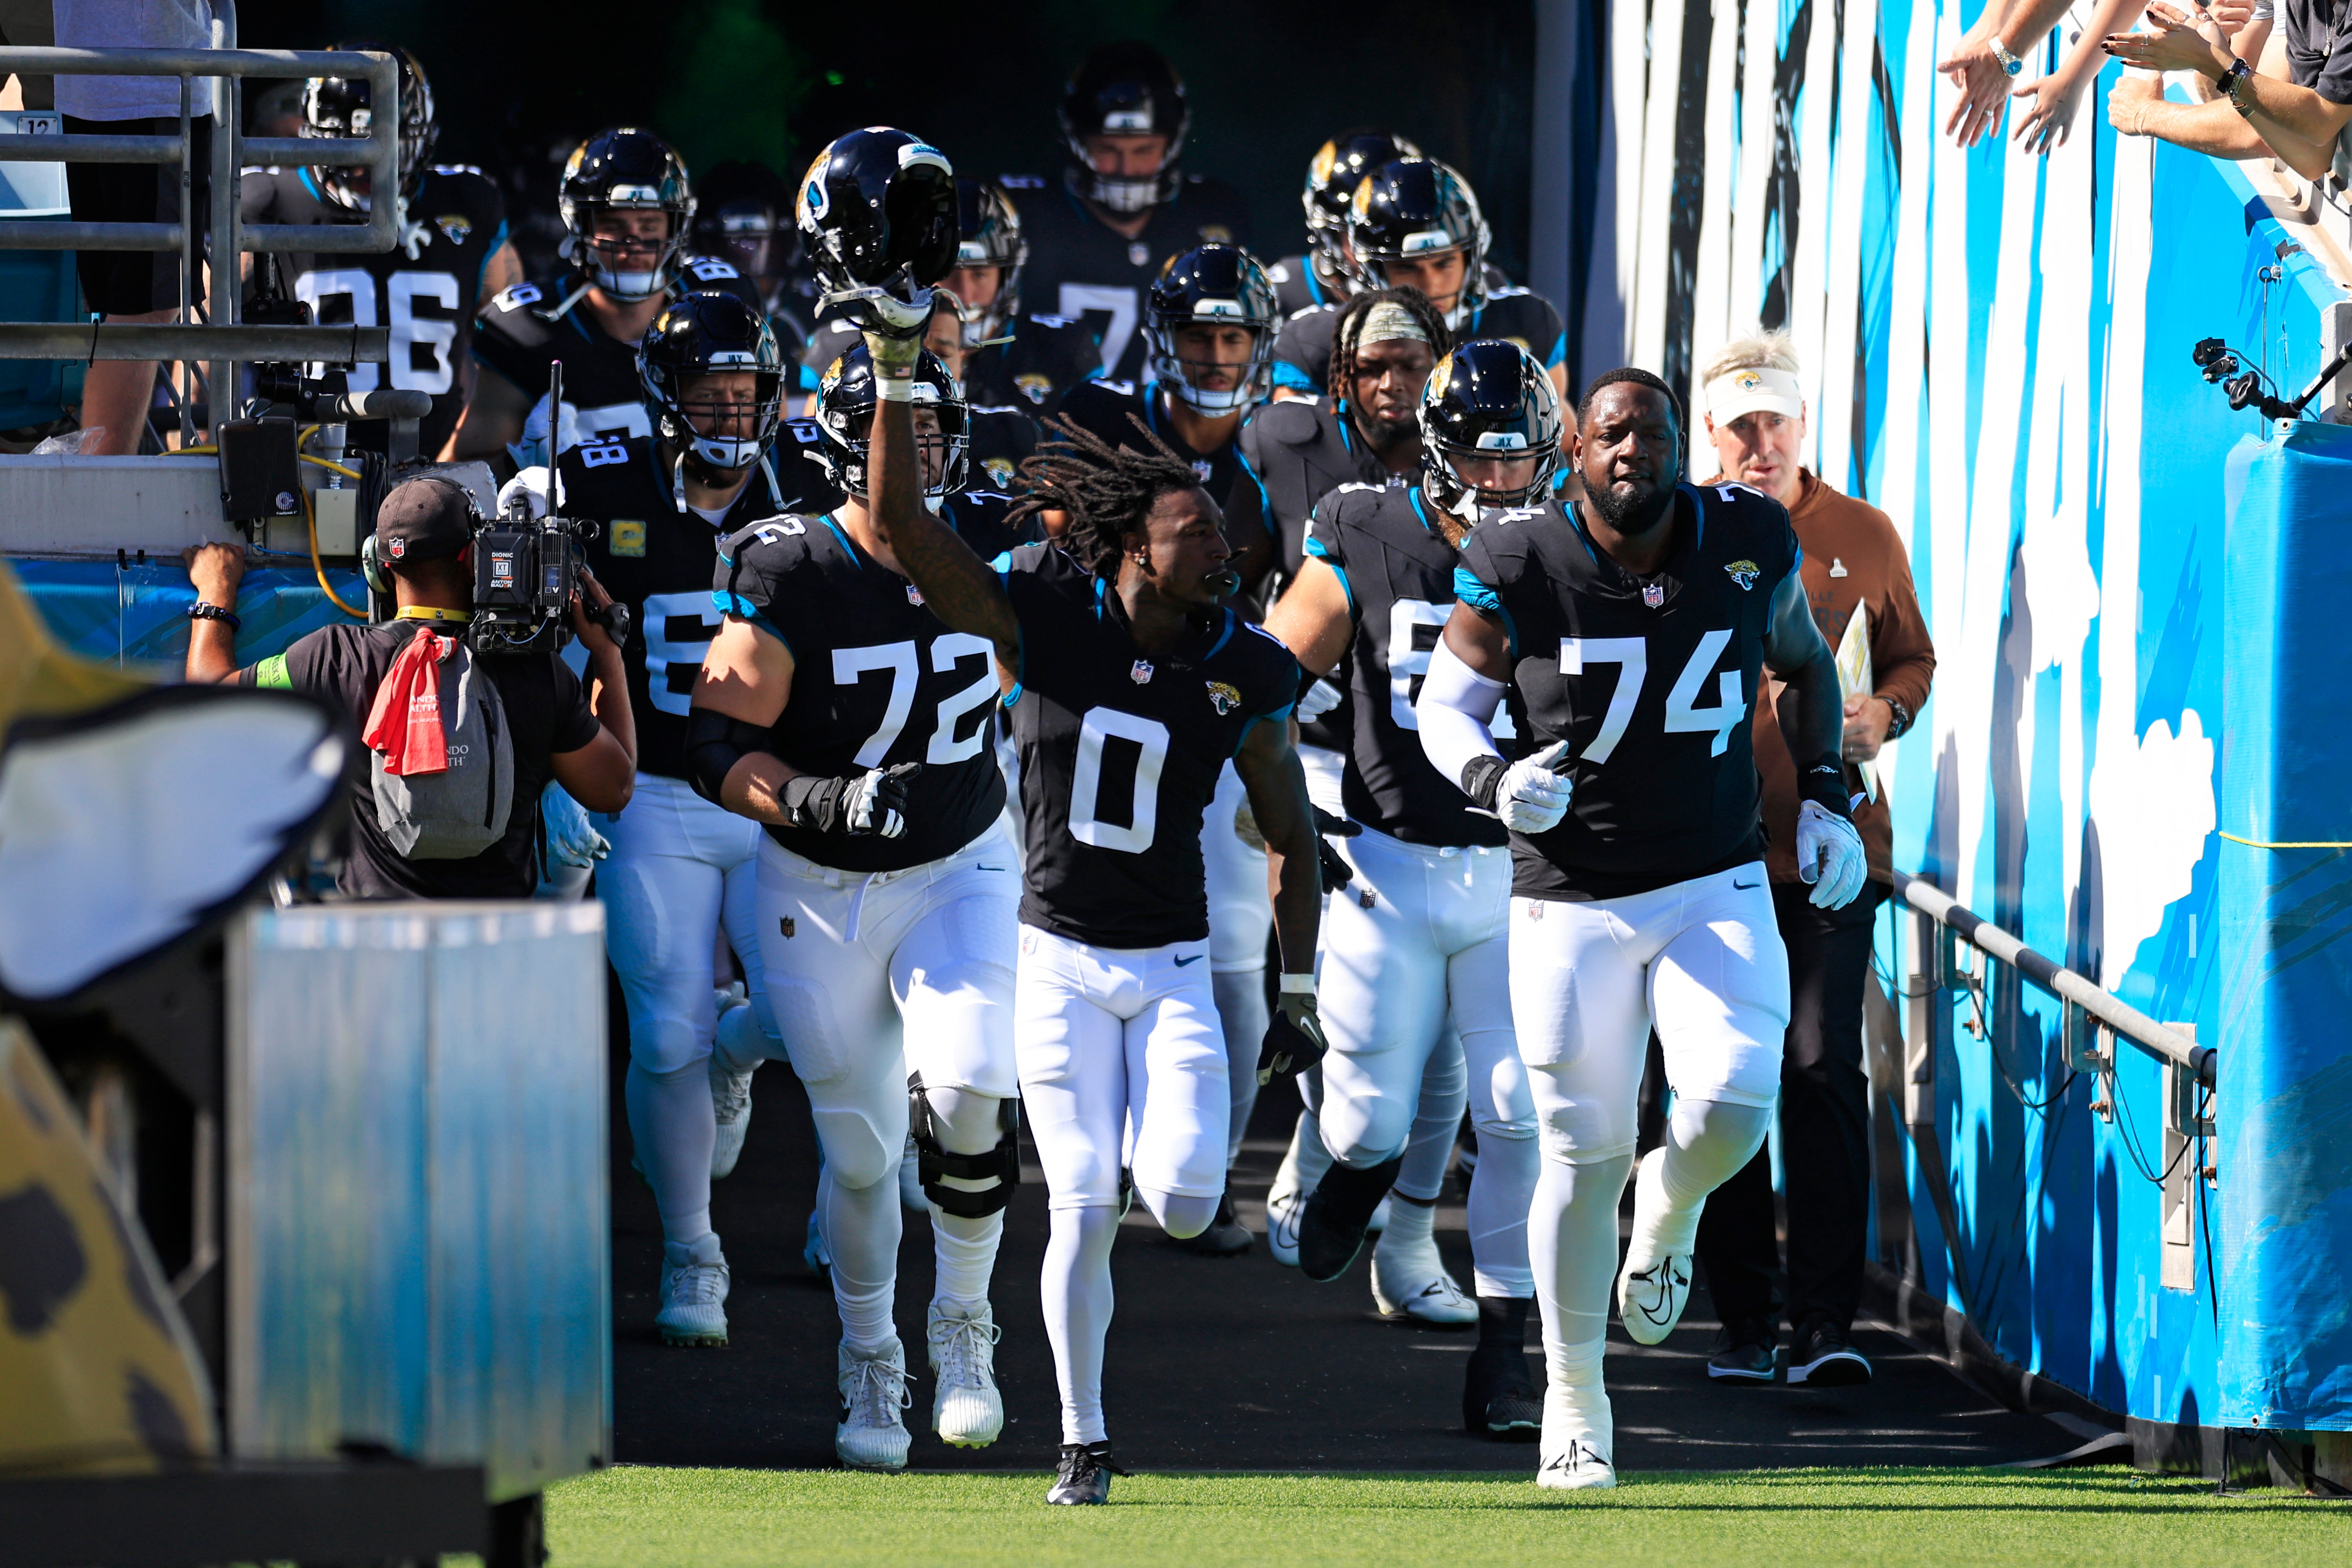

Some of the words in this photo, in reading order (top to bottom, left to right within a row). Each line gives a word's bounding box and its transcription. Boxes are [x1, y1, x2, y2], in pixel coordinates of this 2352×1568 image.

[28, 120, 49, 134] 12
[1494, 437, 1513, 448] JAX
[1647, 595, 1661, 604] NFL
[1134, 669, 1149, 681] NFL
[831, 632, 1000, 768] 72
[1560, 629, 1747, 765] 74
[1067, 706, 1171, 854] 0
[1530, 909, 1541, 918] NFL
